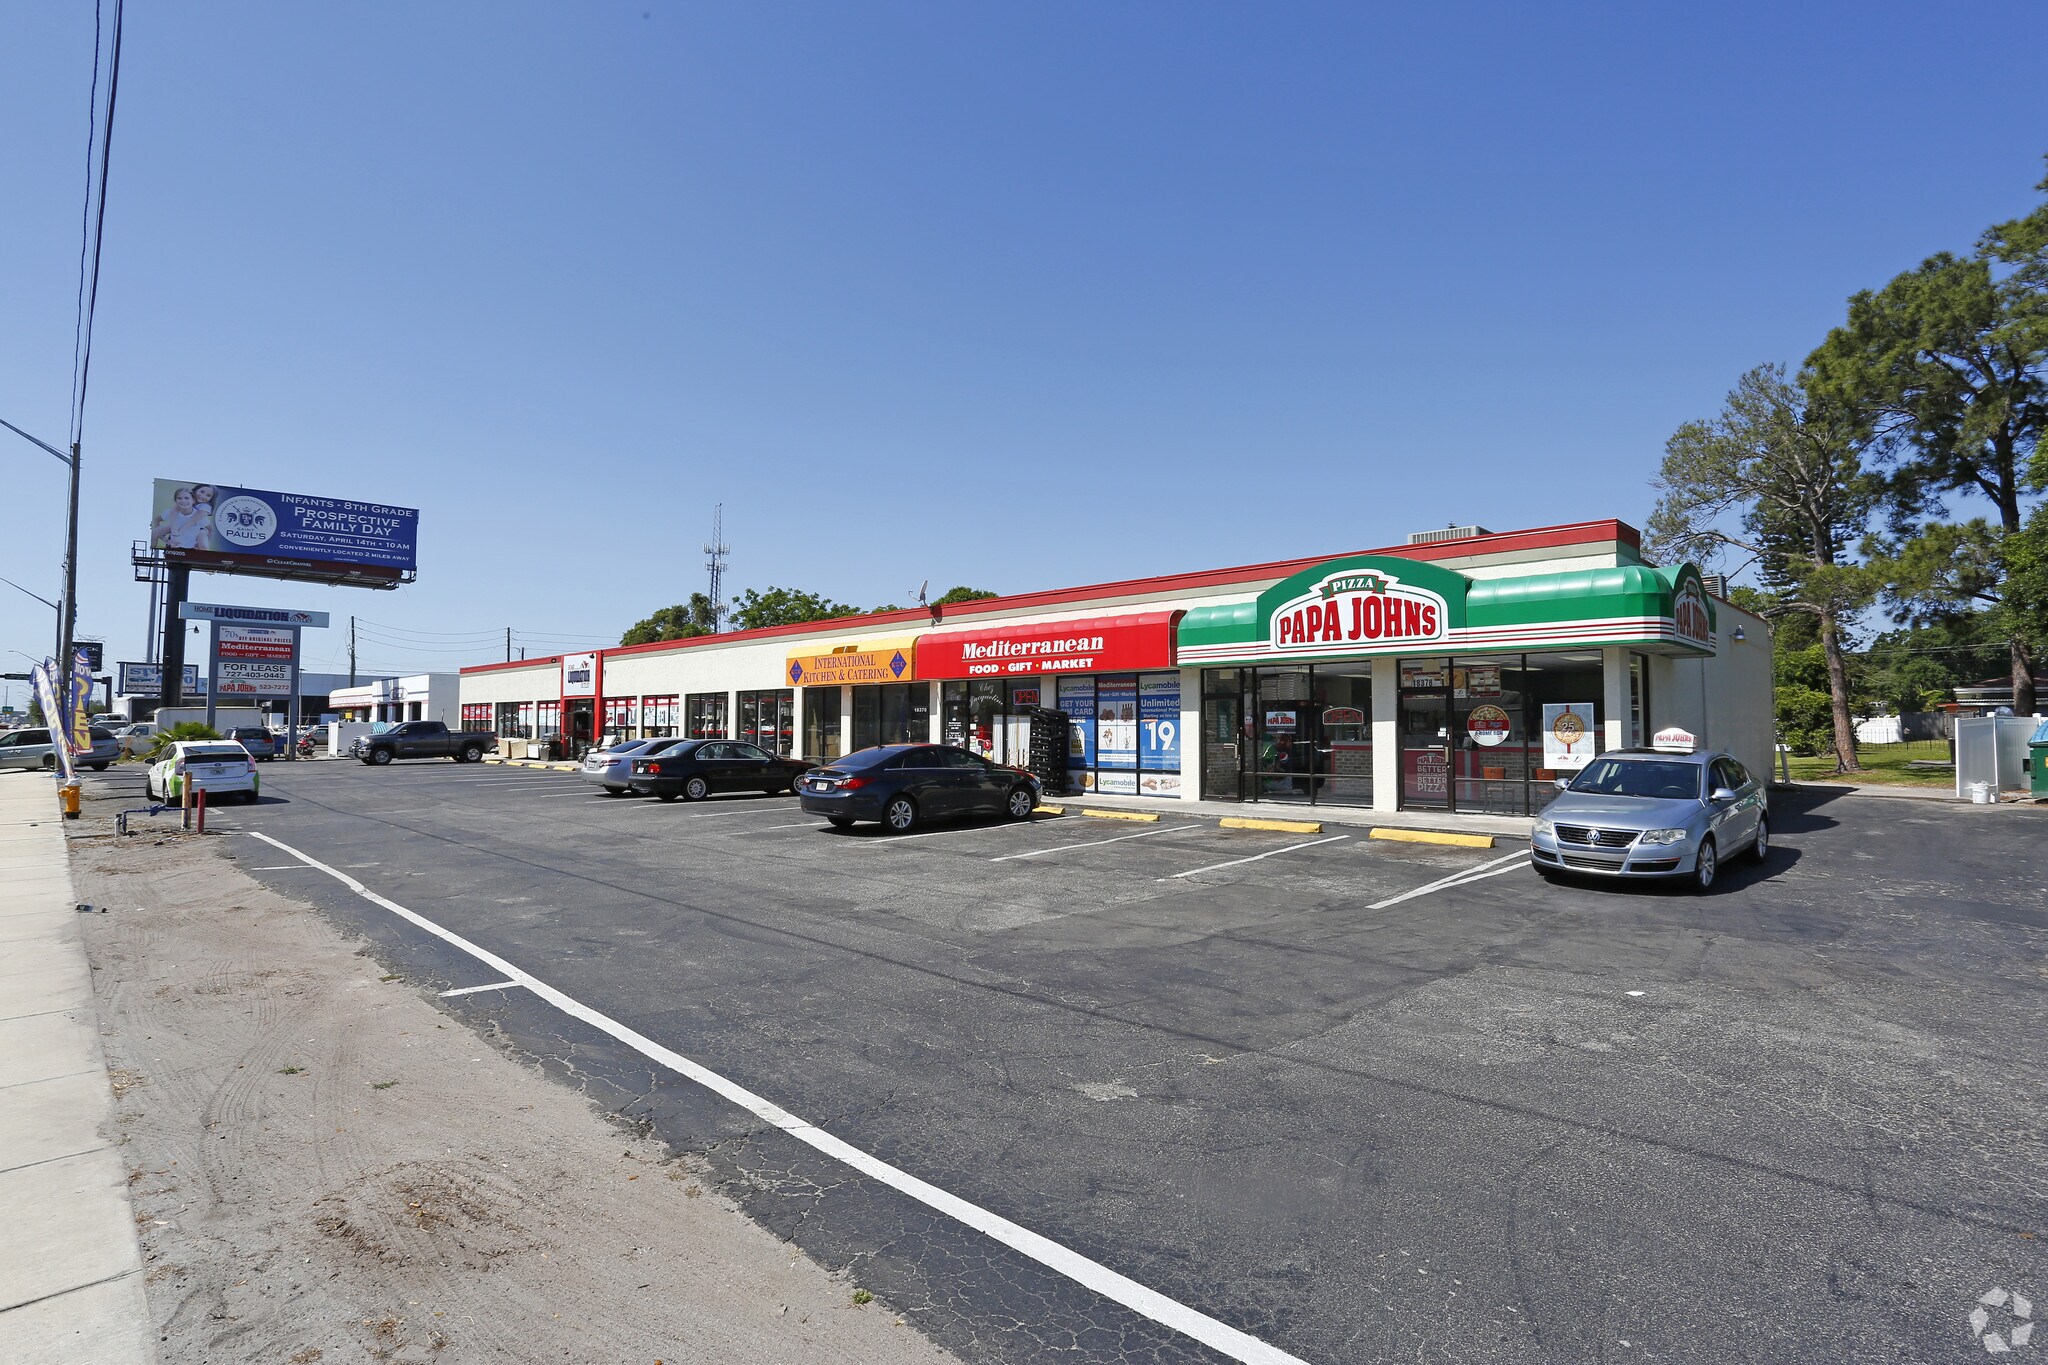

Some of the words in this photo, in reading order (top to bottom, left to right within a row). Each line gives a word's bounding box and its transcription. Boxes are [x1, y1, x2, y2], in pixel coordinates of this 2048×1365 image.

[281, 494, 334, 508] INFANTS
[344, 502, 368, 512] 8TH
[371, 505, 413, 518] GRADE
[294, 506, 400, 528] PROSPECTIVE
[302, 517, 358, 533] FAMILY
[362, 524, 393, 536] DAY
[226, 530, 266, 540] PAUL'S
[328, 536, 354, 545] APRIL
[356, 539, 376, 547] 14TH
[279, 544, 333, 554] CONVENIENTLY
[333, 549, 364, 557] LOCATED
[1331, 577, 1374, 592] PIZZA
[194, 605, 213, 613] HOME
[214, 607, 289, 622] LIQUIDATION
[1279, 599, 1343, 644] PAPA
[1347, 595, 1437, 641] JOHN'S
[1676, 600, 1691, 638] PAPA
[221, 643, 291, 652] Mediterranean
[962, 636, 1104, 659] Mediterranean
[814, 654, 876, 670] INTERNATIONAL
[969, 664, 999, 674] FOOD
[1008, 662, 1032, 672] GIFT
[1041, 658, 1093, 670] MARKET
[223, 663, 248, 672] FOR
[250, 664, 287, 673] LEASE
[225, 671, 285, 679] 727-403-0443
[803, 671, 837, 684] KITCHEN
[839, 671, 845, 681] &
[847, 668, 889, 680] CATERING
[219, 683, 236, 692] PAPA
[1140, 681, 1181, 691] Lycamobile
[1412, 678, 1433, 687] 18378
[1060, 685, 1095, 694] Lycamobile
[1014, 689, 1039, 704] OPEN
[1140, 698, 1180, 707] Unlimited
[1074, 708, 1094, 716] CARD
[1324, 709, 1362, 723] OPEN
[1267, 716, 1279, 725] PAPA
[1562, 722, 1575, 732] 25
[1655, 733, 1671, 742] PAPA
[1417, 765, 1447, 773] BETTER
[1099, 776, 1136, 787] Lycamobile
[1417, 776, 1447, 784] BETTER
[1417, 783, 1447, 793] PIZZA
